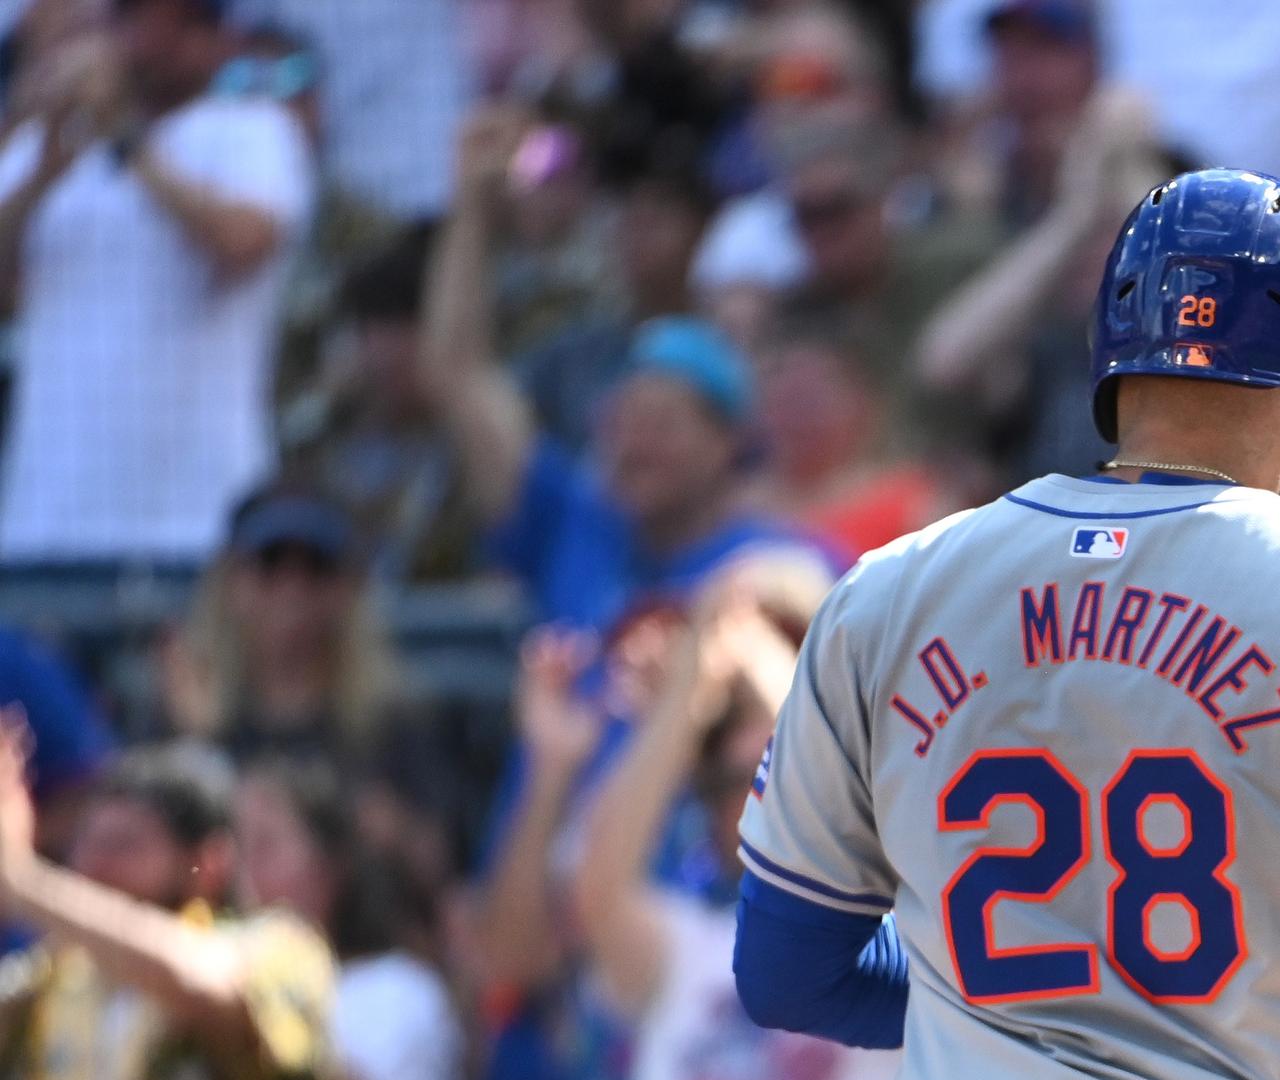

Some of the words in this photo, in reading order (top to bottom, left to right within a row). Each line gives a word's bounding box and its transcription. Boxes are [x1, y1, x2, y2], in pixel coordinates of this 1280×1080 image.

[1178, 295, 1217, 328] 28
[891, 636, 989, 758] J.D.
[937, 747, 1250, 1006] 28
